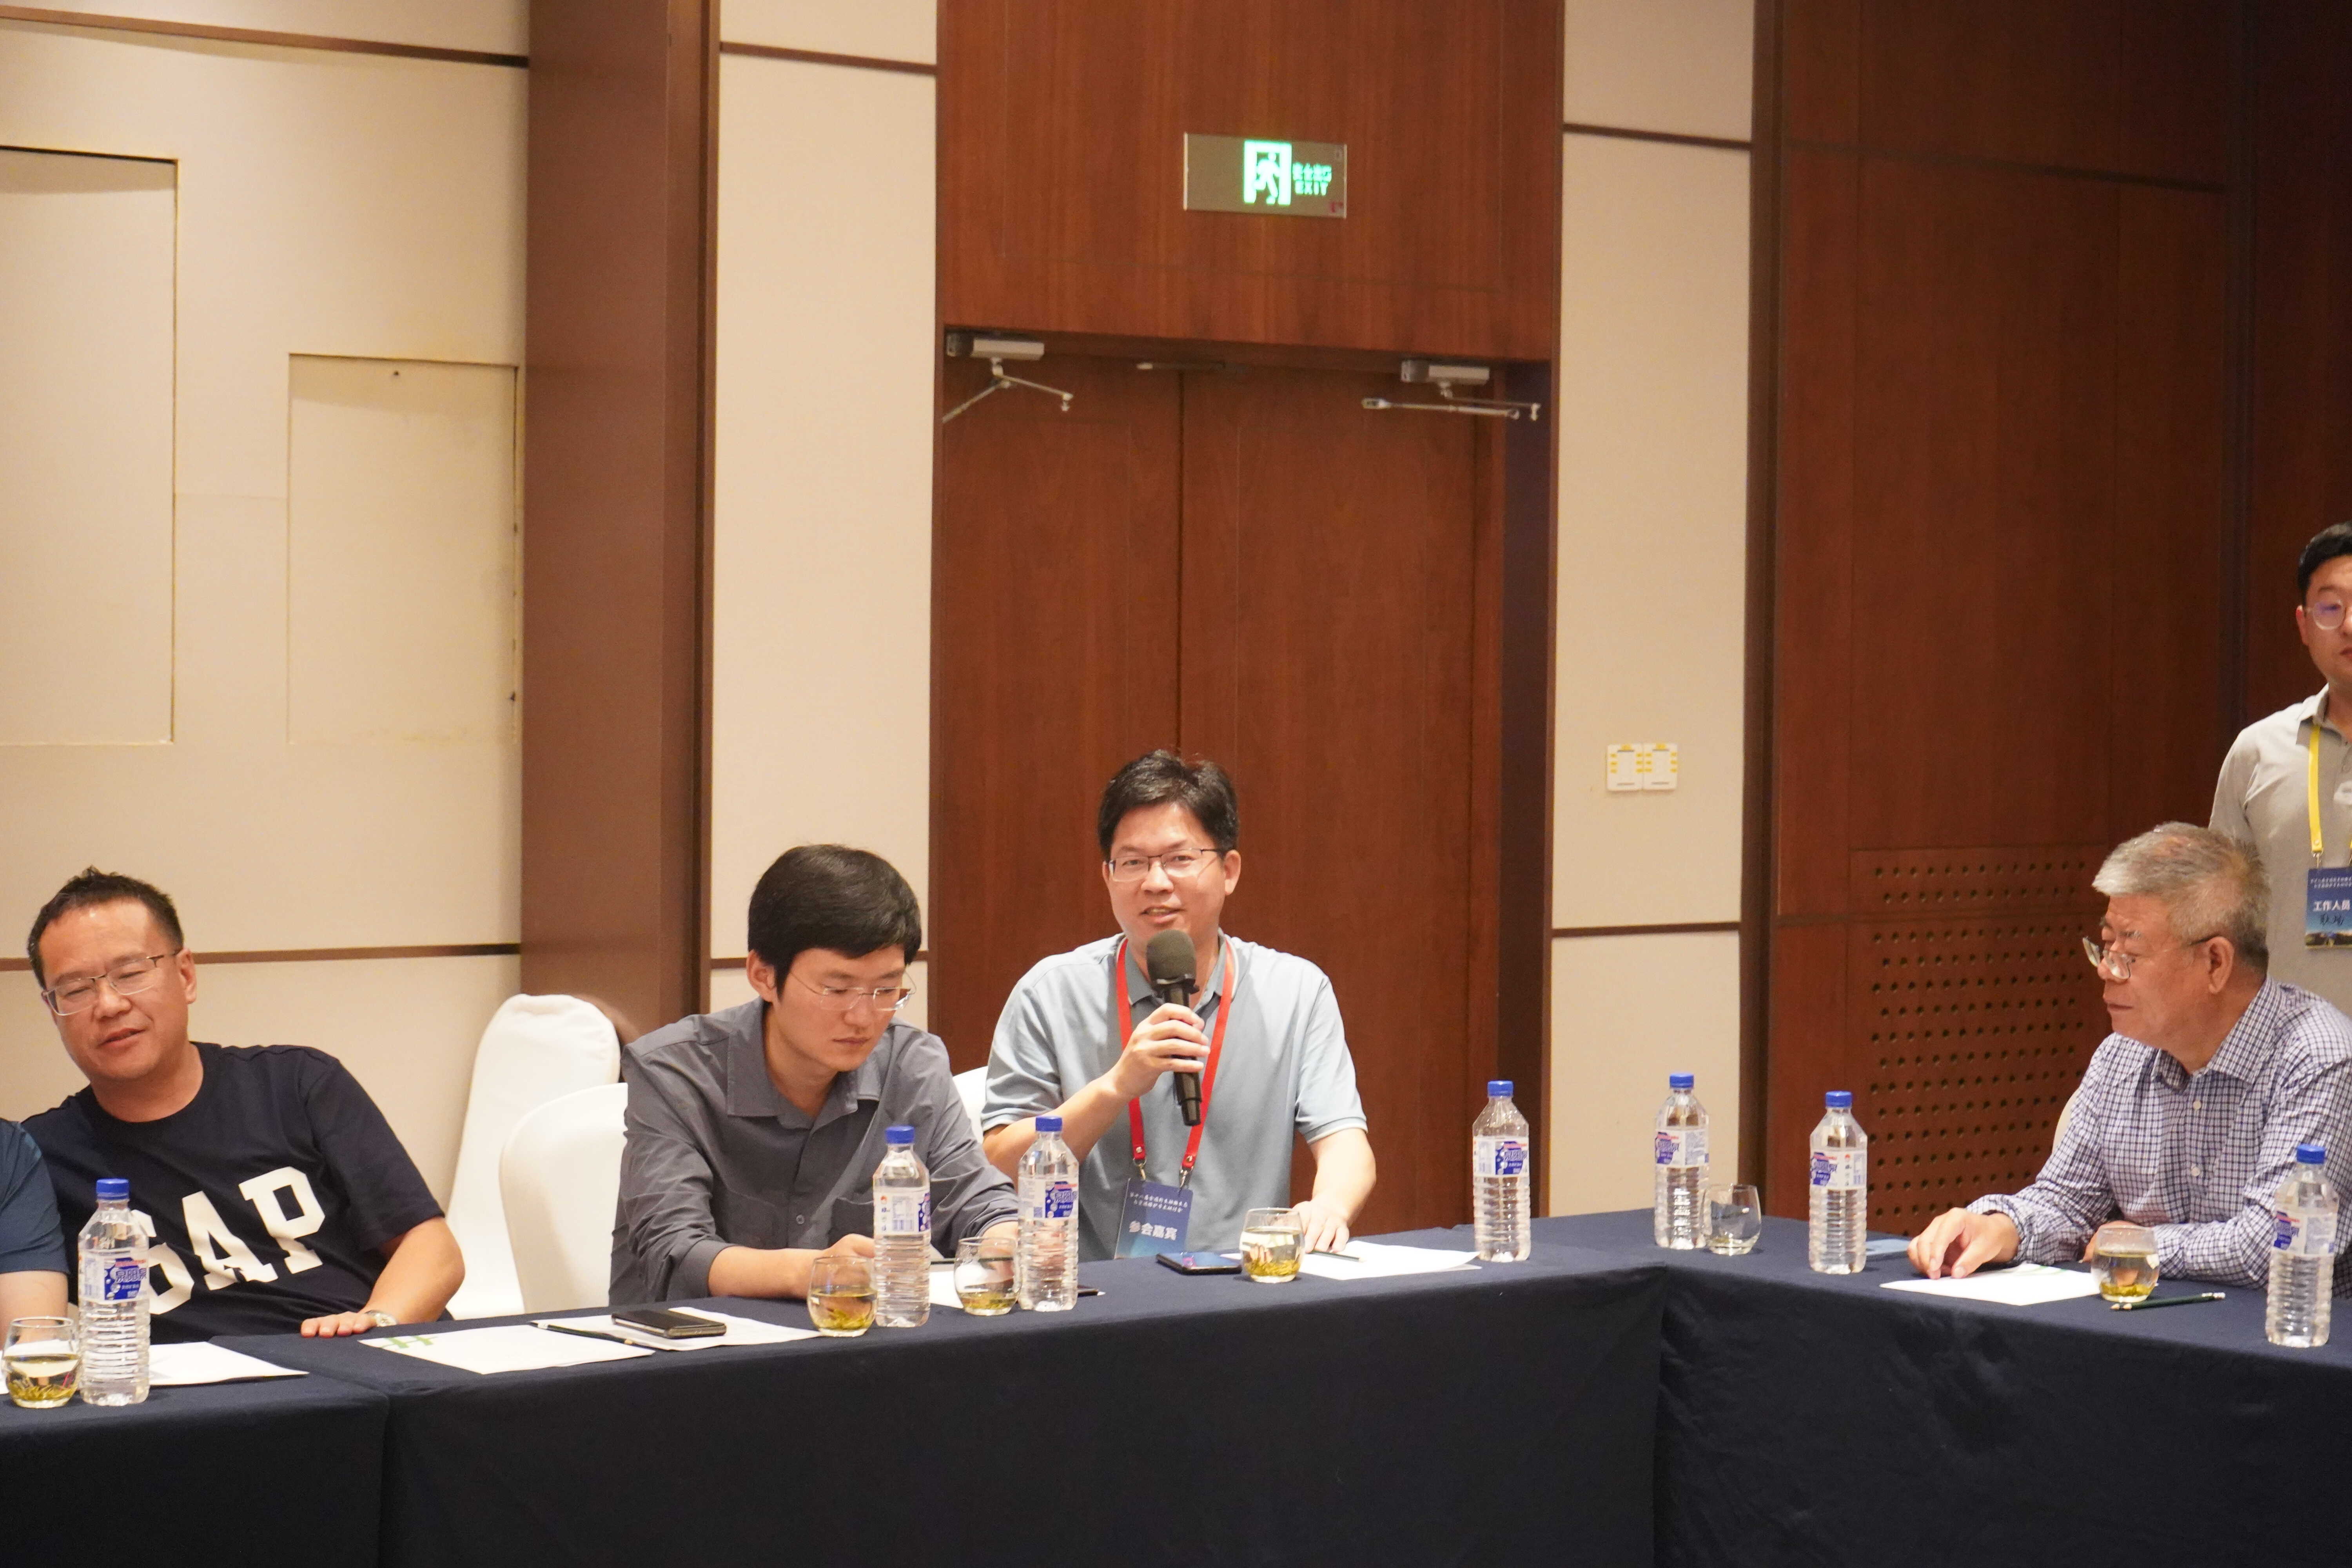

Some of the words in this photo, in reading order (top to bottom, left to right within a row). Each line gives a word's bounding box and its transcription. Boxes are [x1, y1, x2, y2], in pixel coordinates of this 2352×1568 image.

[1295, 180, 1329, 196] EXIT
[2313, 900, 2350, 911] 工作人员
